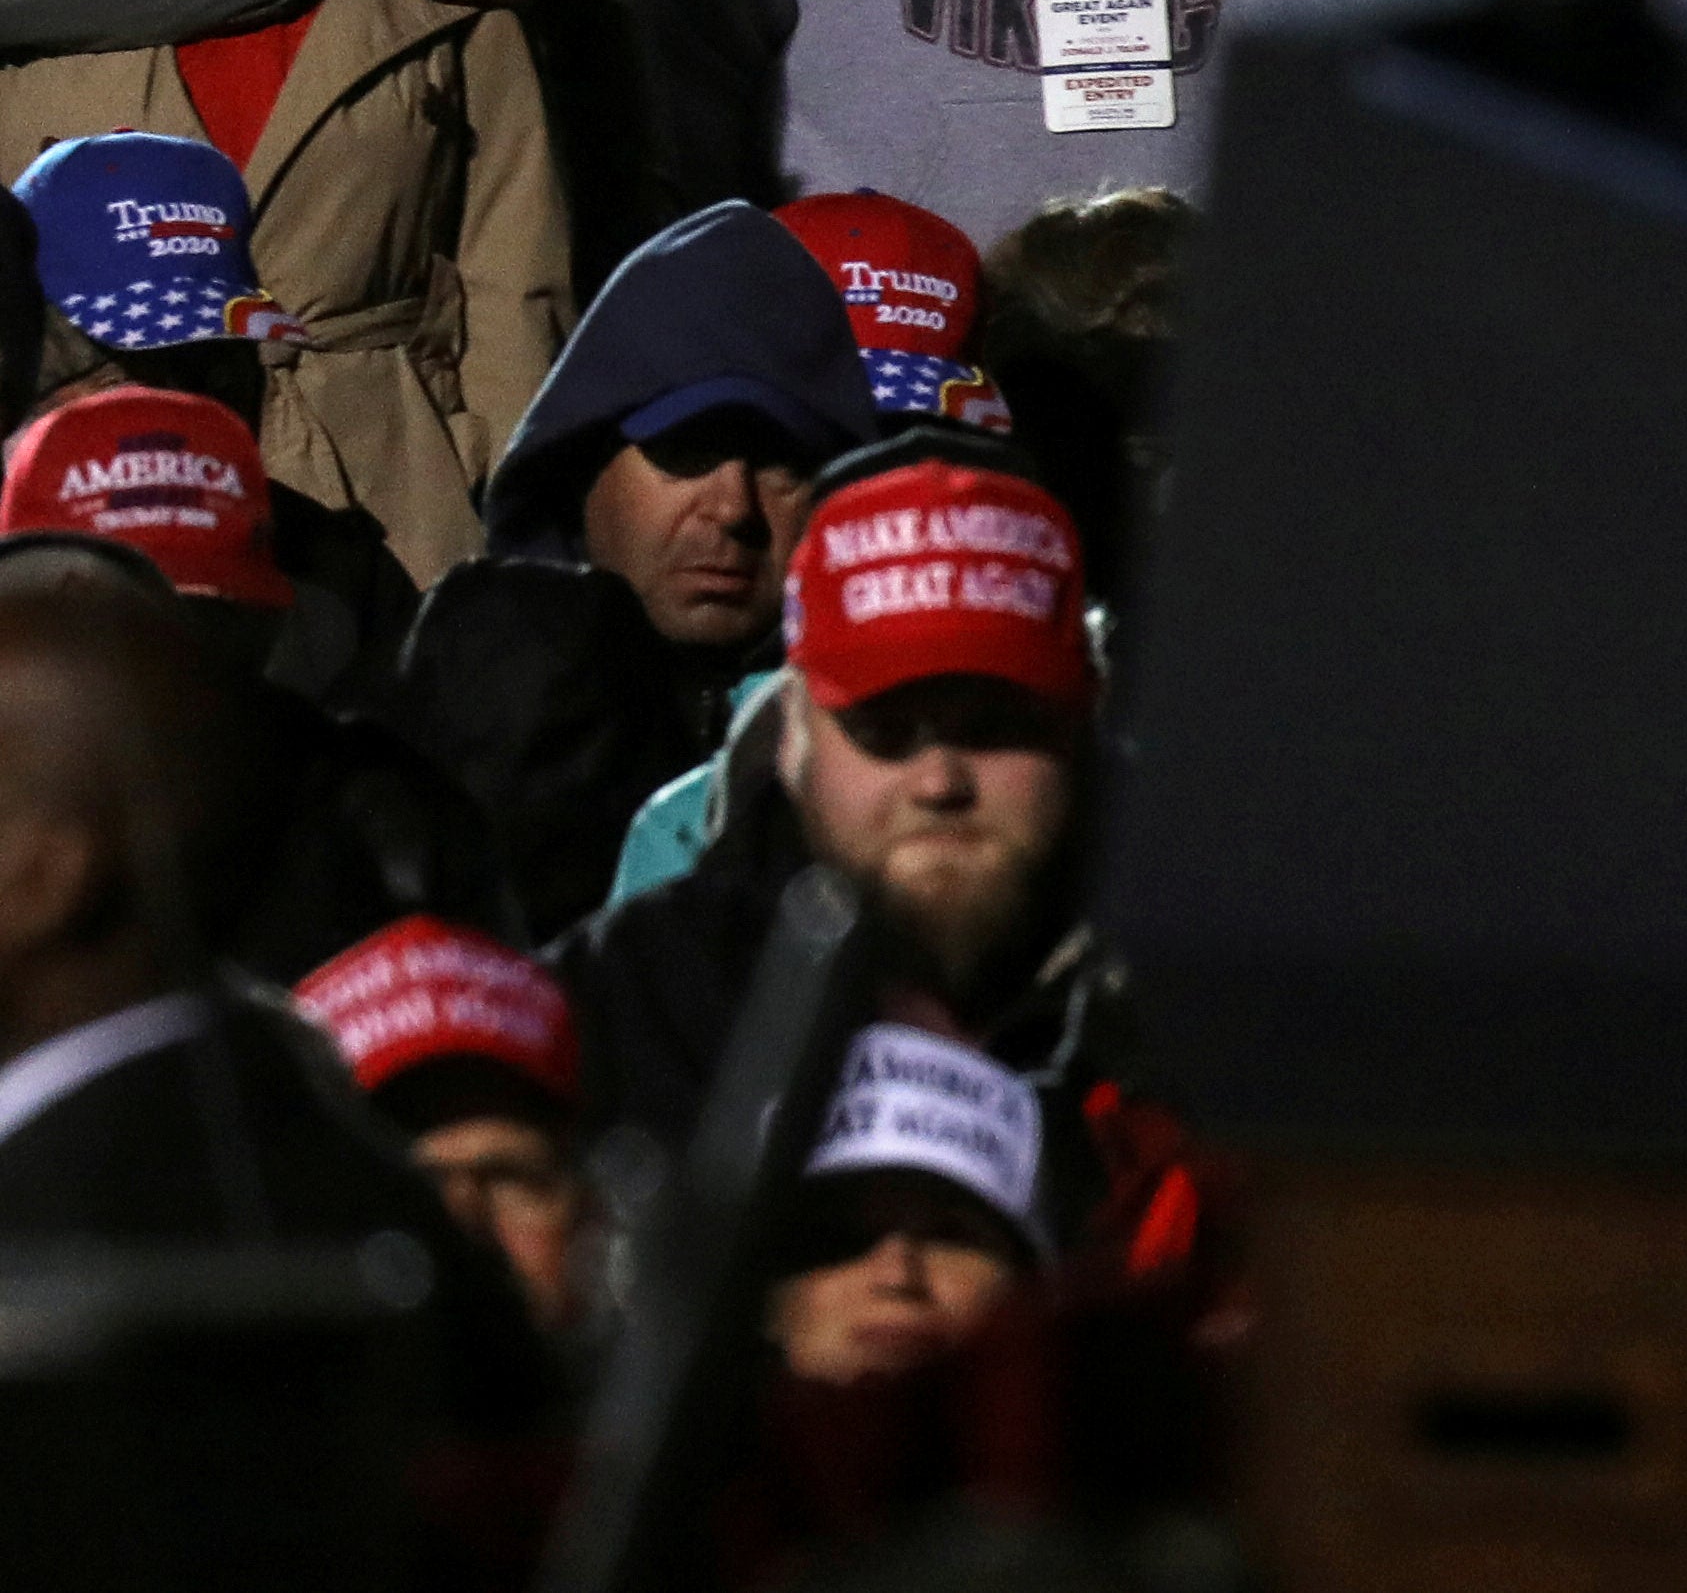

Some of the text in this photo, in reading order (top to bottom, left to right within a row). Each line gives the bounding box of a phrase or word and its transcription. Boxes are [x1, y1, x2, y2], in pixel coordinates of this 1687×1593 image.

[1050, 1, 1099, 14] GREAT
[1078, 12, 1128, 25] EVENT
[1064, 76, 1154, 91] EXPEDITED
[1084, 89, 1135, 102] ENTRY
[106, 199, 227, 233] Trump
[147, 237, 221, 257] 2020
[840, 261, 959, 306] Trump
[875, 304, 946, 331] 2020
[56, 451, 243, 500] AMERICA
